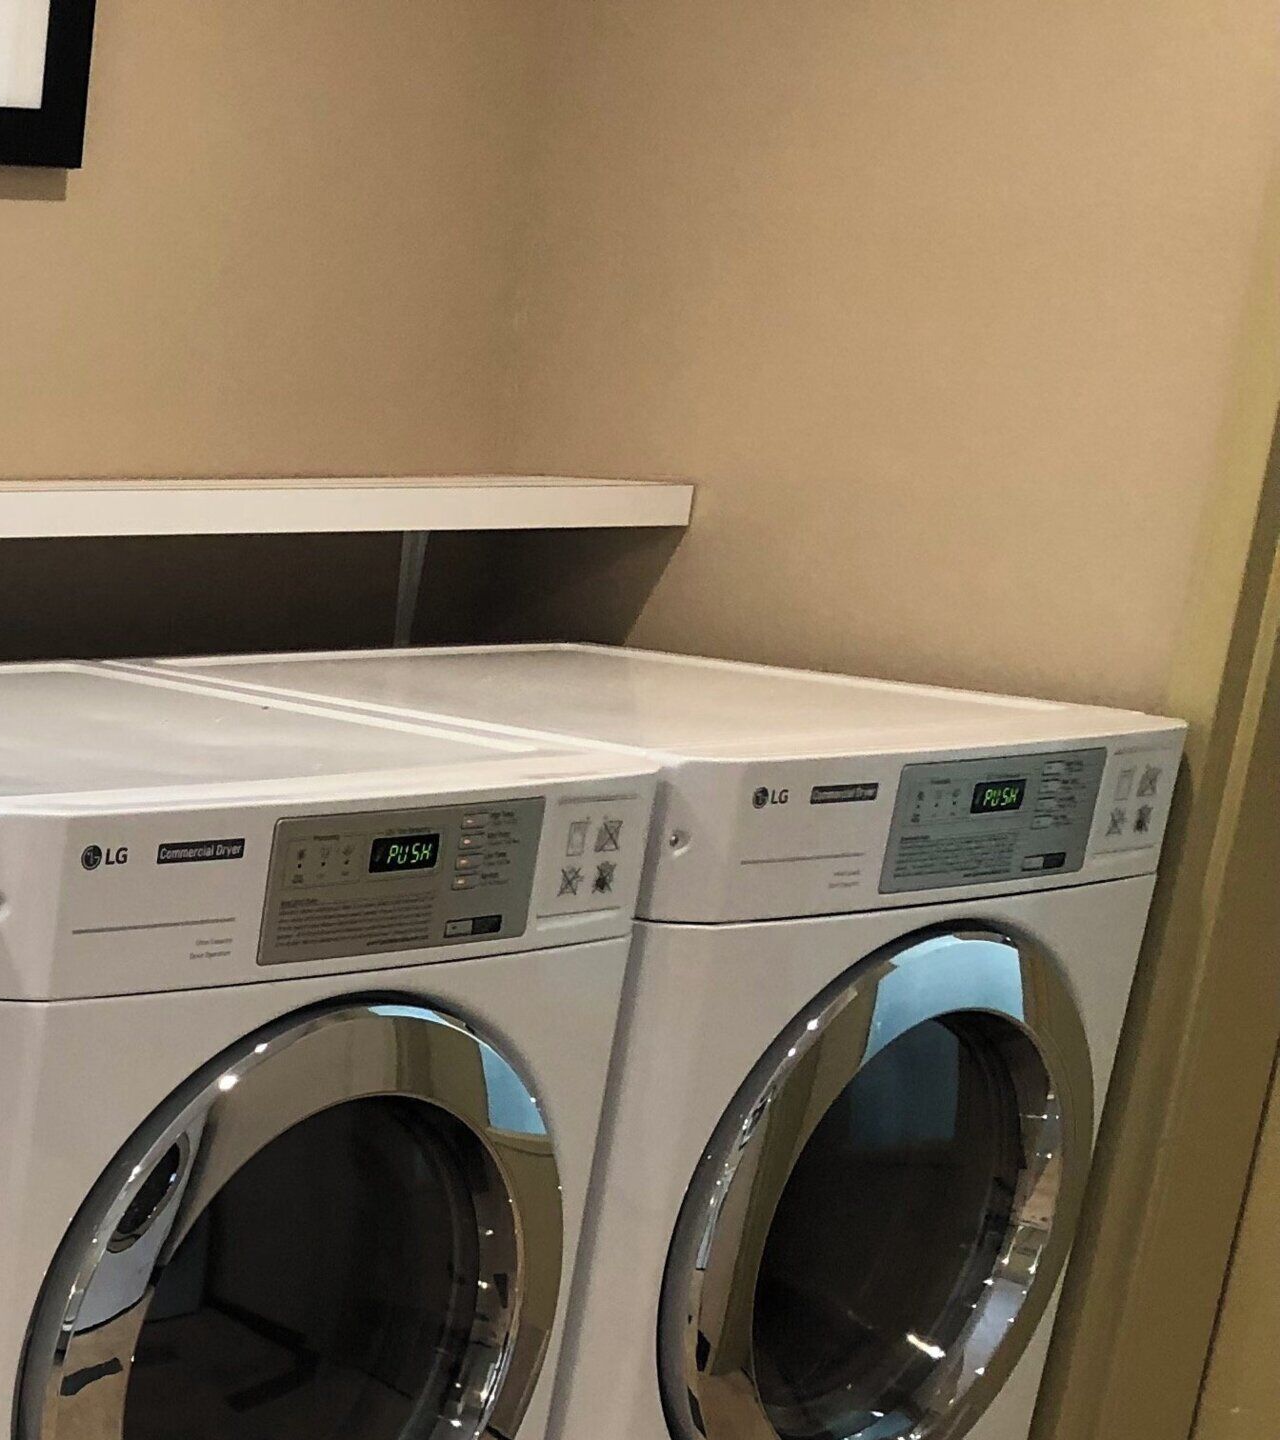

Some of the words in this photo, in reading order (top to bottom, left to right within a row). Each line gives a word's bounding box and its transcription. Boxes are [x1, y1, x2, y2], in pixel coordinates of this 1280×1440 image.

[770, 789, 789, 804] LG
[983, 787, 1019, 807] PUSH
[105, 847, 128, 865] LG
[159, 845, 214, 860] Commercial
[216, 844, 242, 857] Dryer
[387, 843, 432, 865] PUSH
